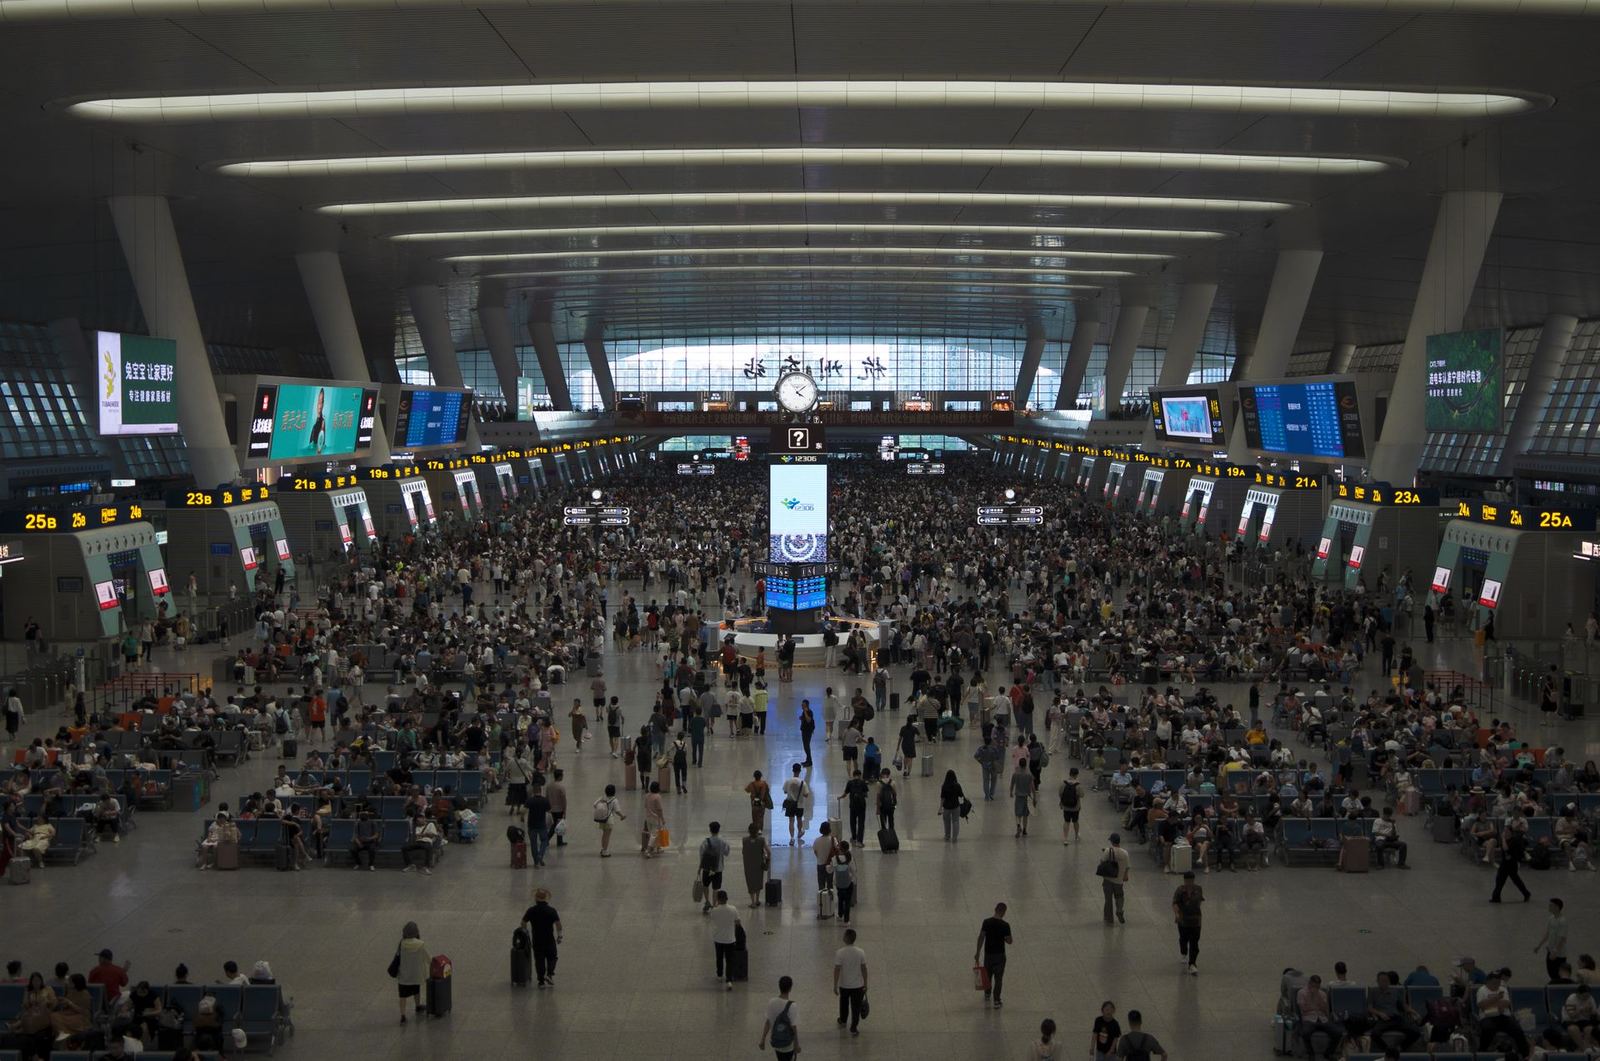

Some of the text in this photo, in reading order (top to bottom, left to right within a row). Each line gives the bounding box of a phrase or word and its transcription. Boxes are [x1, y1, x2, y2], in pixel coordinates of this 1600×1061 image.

[125, 361, 174, 382] 兔宝宝 让家更好
[427, 461, 444, 470] 17B
[1175, 460, 1191, 468] 17A
[369, 469, 388, 478] 19B
[1227, 467, 1245, 477] 19A
[294, 479, 316, 490] 21B
[1296, 477, 1317, 488] 21A
[187, 492, 212, 505] 23B
[1394, 491, 1420, 504] 23A
[130, 505, 142, 519] 24B
[1510, 510, 1522, 526] 25A
[25, 514, 57, 529] 25B
[72, 513, 86, 528] 25B
[1540, 512, 1572, 527] 25A
